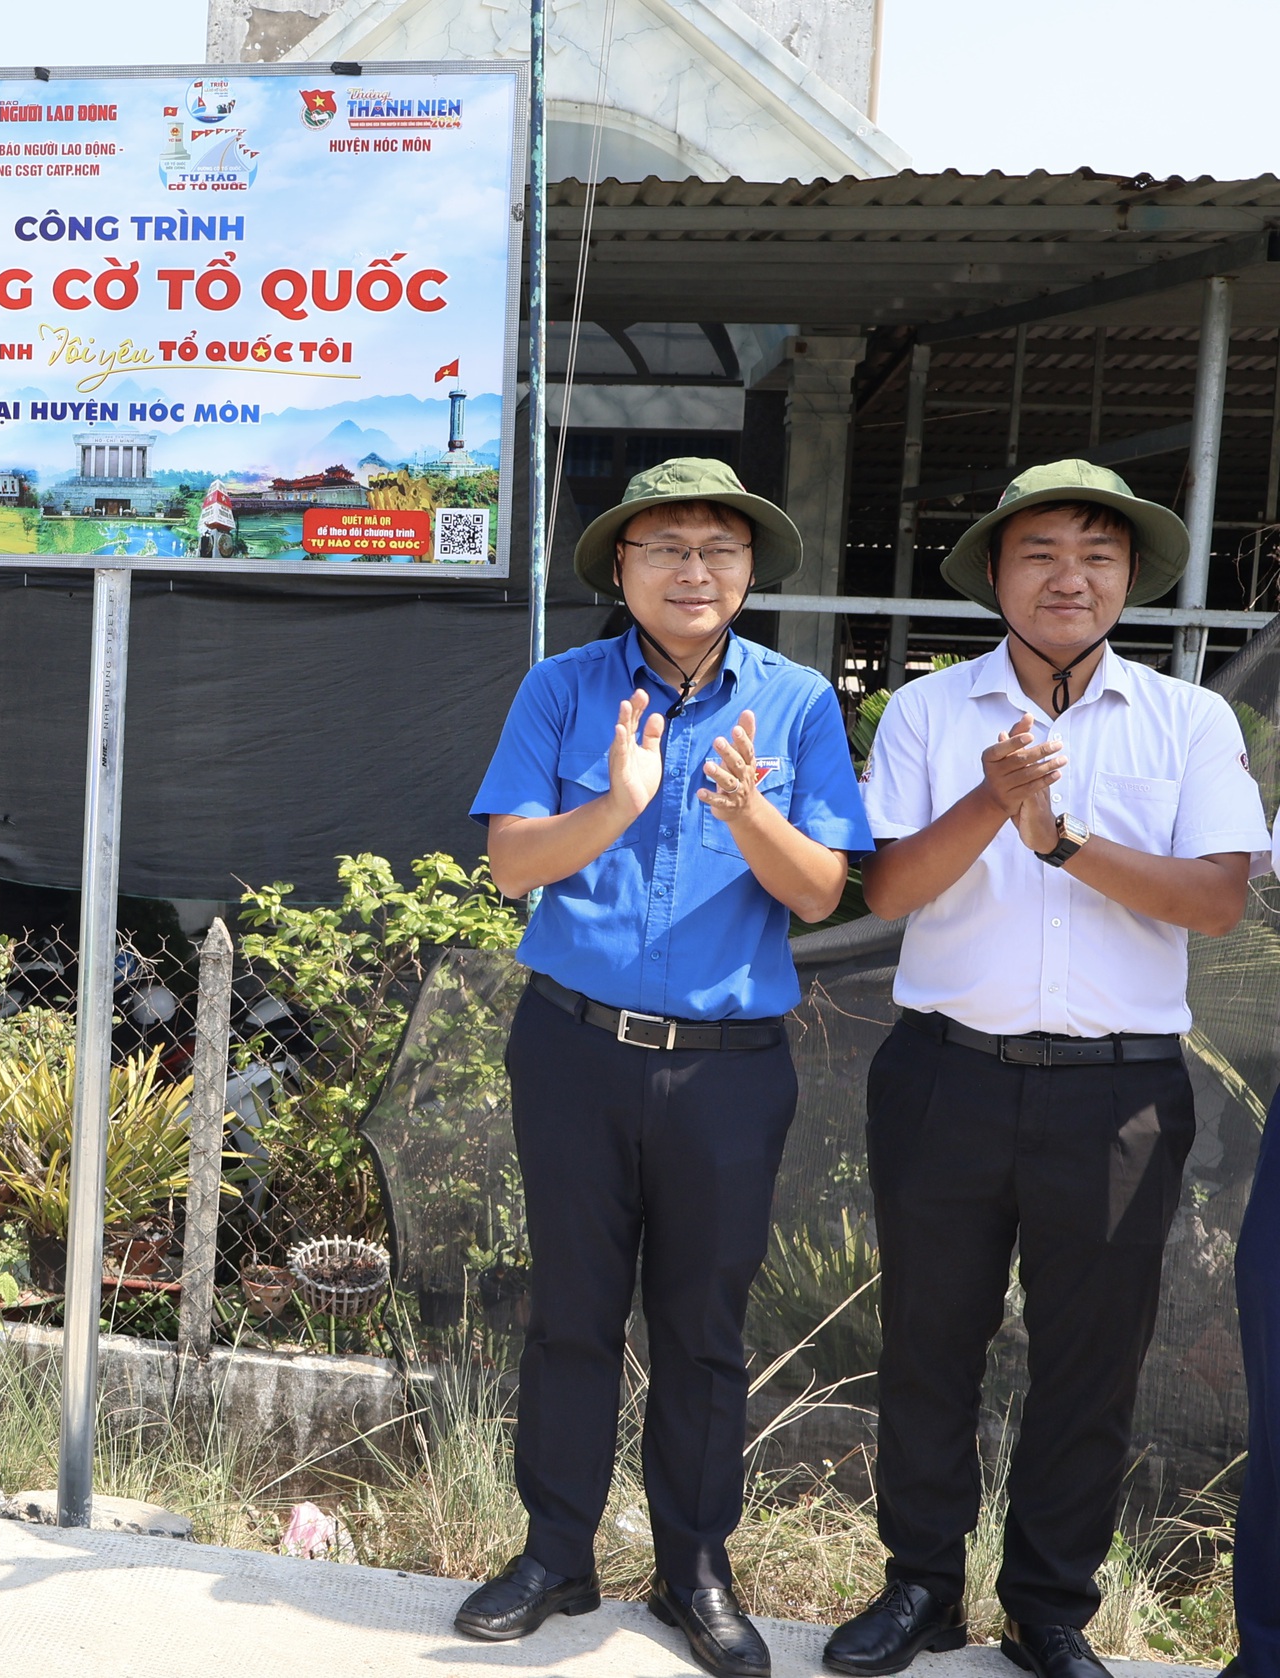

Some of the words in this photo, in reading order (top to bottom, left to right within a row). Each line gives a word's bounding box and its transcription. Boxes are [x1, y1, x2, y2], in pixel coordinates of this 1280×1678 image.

[46, 105, 74, 122] LAO
[77, 103, 117, 122] ĐỘNG
[347, 100, 413, 117] THANH
[417, 97, 461, 117] NIÊN
[430, 117, 460, 129] 2024
[0, 141, 21, 157] BÁO
[24, 141, 58, 156] NGƯỜI
[61, 143, 82, 156] LAO
[85, 141, 116, 158] ĐỘNG
[330, 137, 370, 155] HUYỆN
[374, 137, 398, 152] HÓC
[402, 137, 431, 152] MÔN
[15, 164, 43, 176] CSGT
[46, 164, 100, 176] CATP.HCM
[15, 209, 119, 241] CÔNG
[130, 208, 245, 241] TRÌNH
[52, 257, 140, 310] CỜ
[157, 251, 241, 311] TỔ
[261, 253, 449, 320] QUỐC
[76, 338, 154, 393] yêu
[159, 330, 198, 362] TỔ
[205, 334, 293, 363] QUỐC
[299, 337, 352, 363] TÔI
[31, 398, 118, 426] HUYỆN
[129, 399, 185, 422] HÓC
[194, 400, 260, 423] MÔN
[341, 514, 362, 525] QUÉT
[364, 515, 378, 525] MÃ
[380, 516, 391, 526] QR
[317, 525, 328, 536] để
[330, 527, 347, 536] theo
[364, 527, 394, 538] chương
[396, 528, 415, 538] trình
[328, 537, 351, 548] HÀO
[354, 537, 370, 549] CỜ
[106, 611, 114, 654] STEEL
